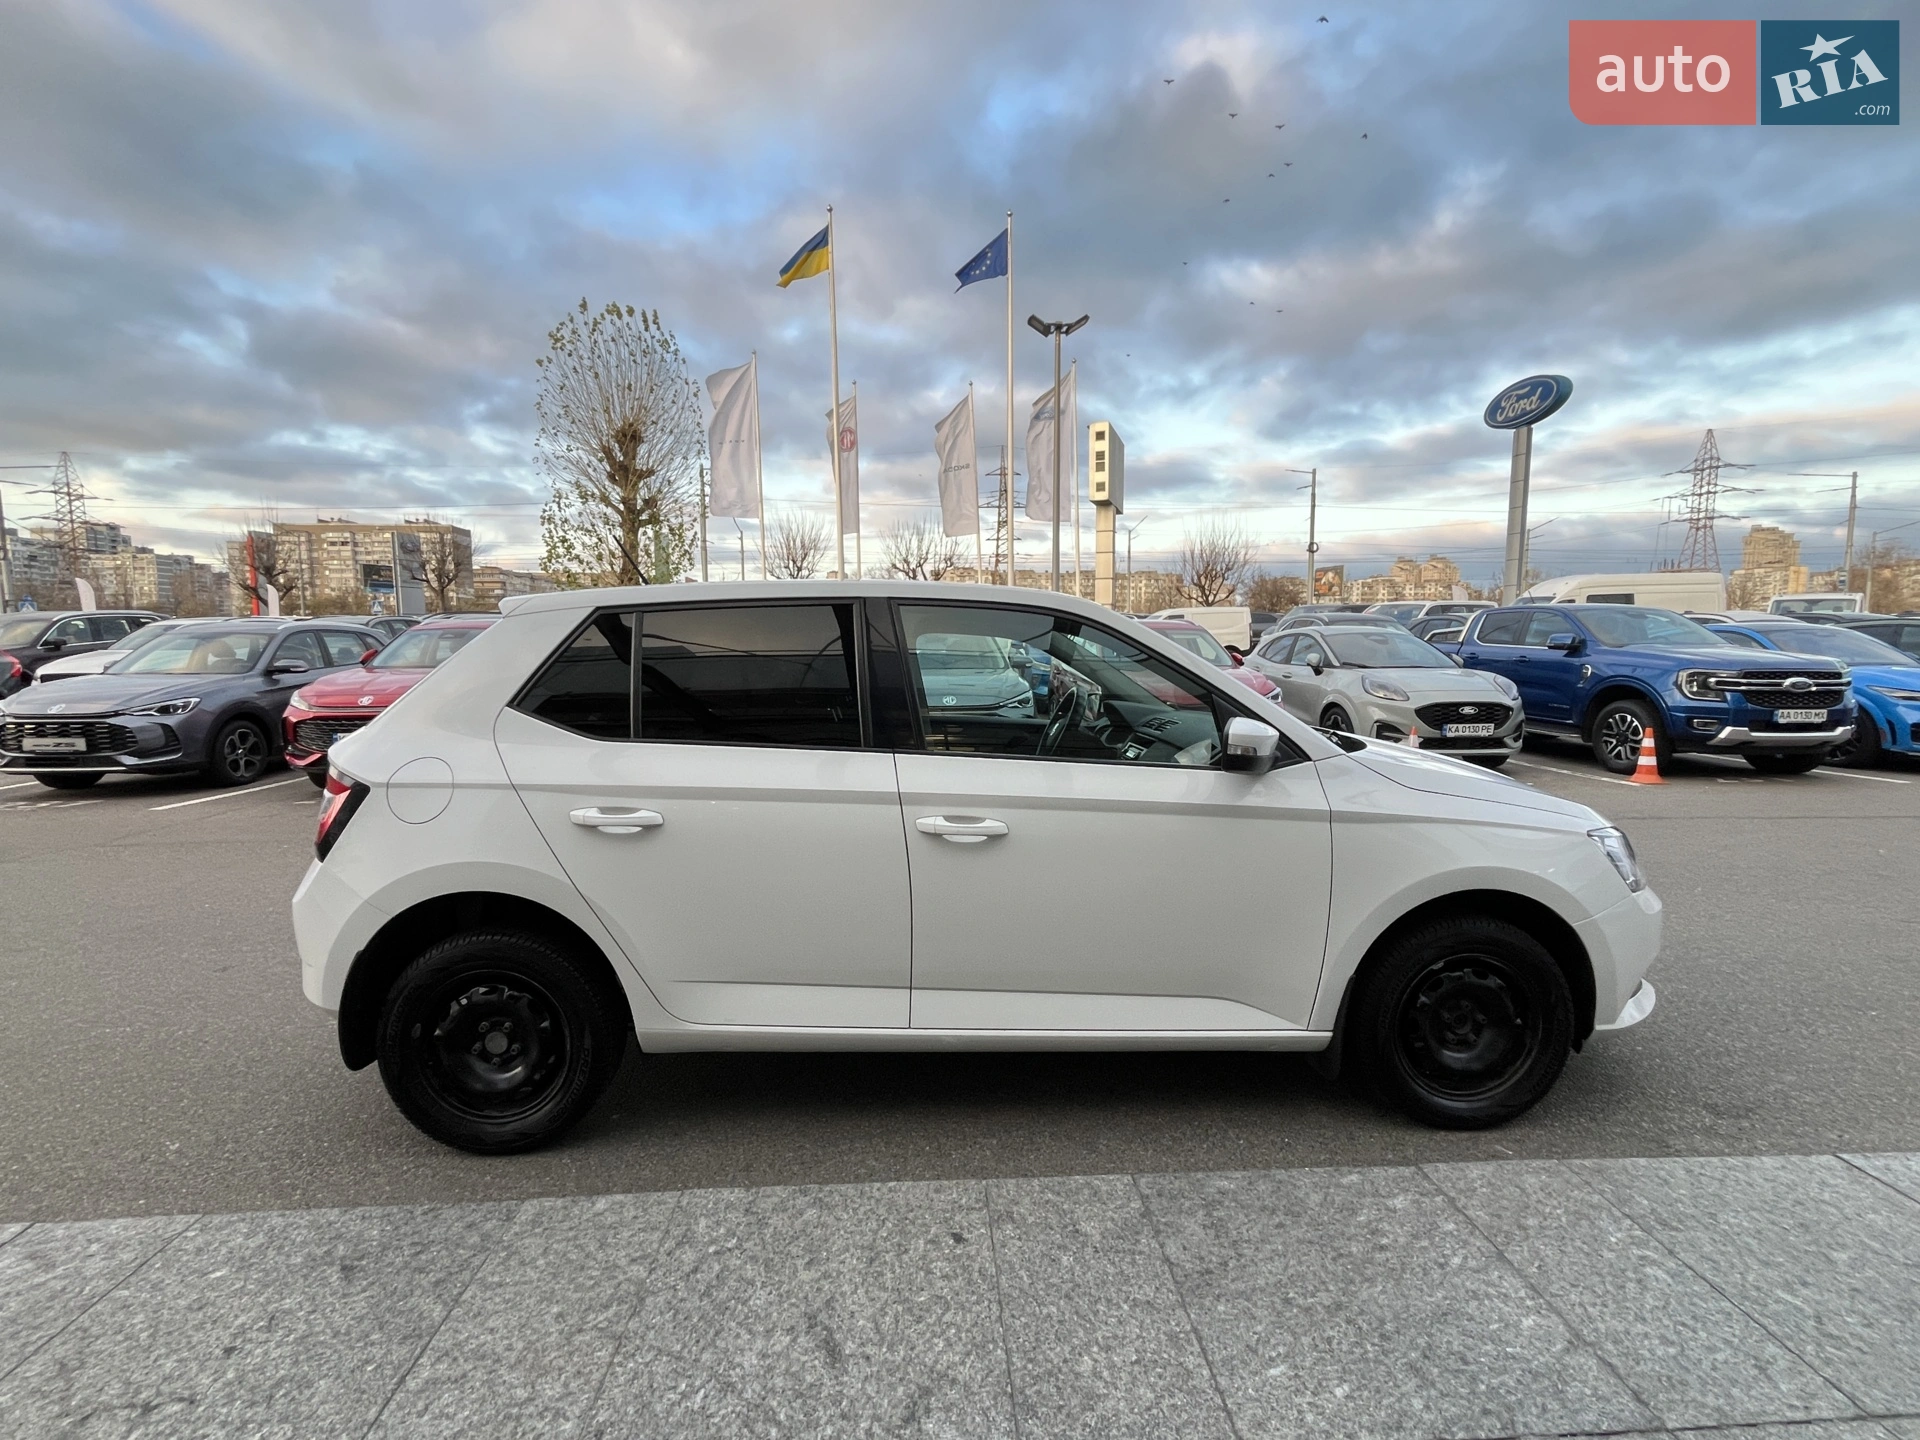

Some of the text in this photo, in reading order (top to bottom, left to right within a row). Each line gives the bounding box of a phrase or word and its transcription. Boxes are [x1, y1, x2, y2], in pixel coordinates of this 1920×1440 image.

[1496, 385, 1543, 422] Ford
[1779, 711, 1825, 720] AA 0130 MX
[1448, 724, 1492, 734] KA 0130 PE
